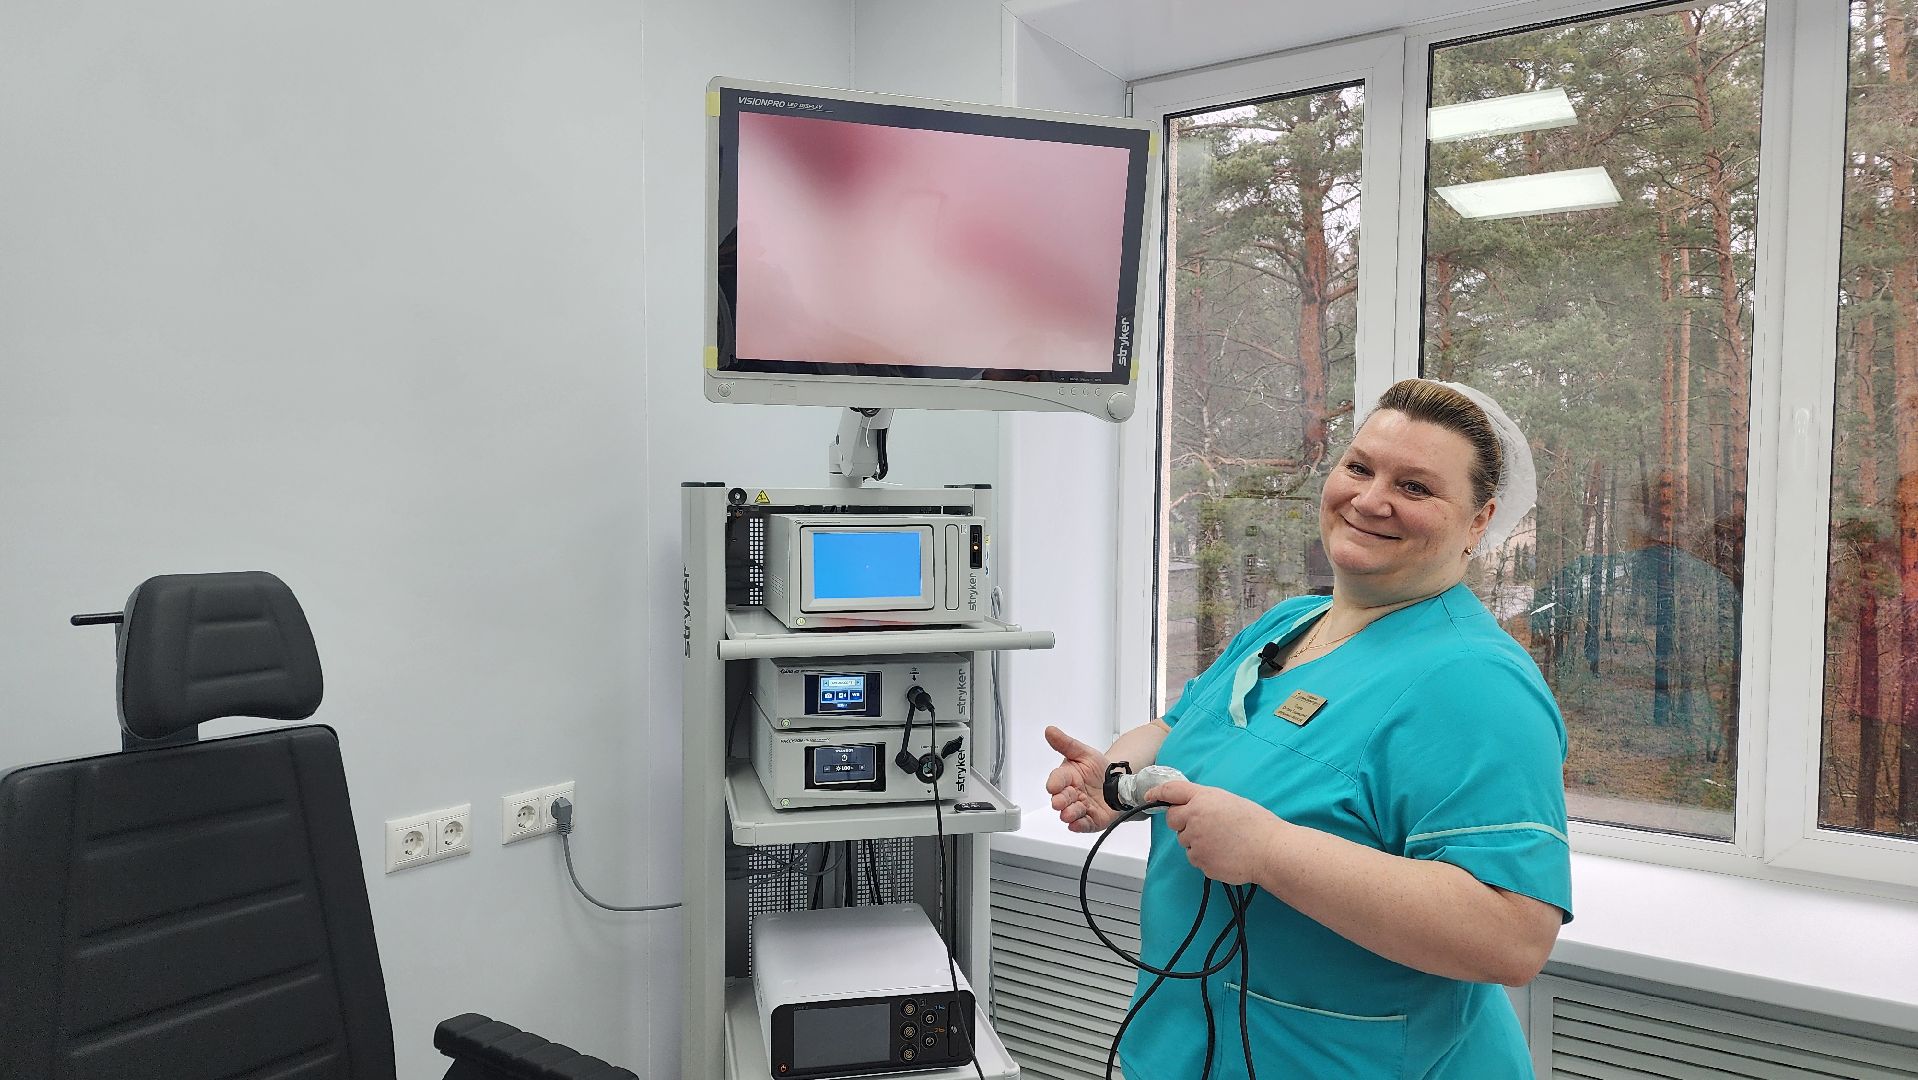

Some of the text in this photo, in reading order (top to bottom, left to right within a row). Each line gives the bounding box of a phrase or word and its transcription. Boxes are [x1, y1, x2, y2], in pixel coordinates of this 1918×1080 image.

[738, 96, 786, 108] VISIONPRO
[1117, 316, 1130, 367] stryker
[682, 562, 691, 658] stryker
[968, 572, 979, 612] stryker
[957, 668, 967, 715] stryker
